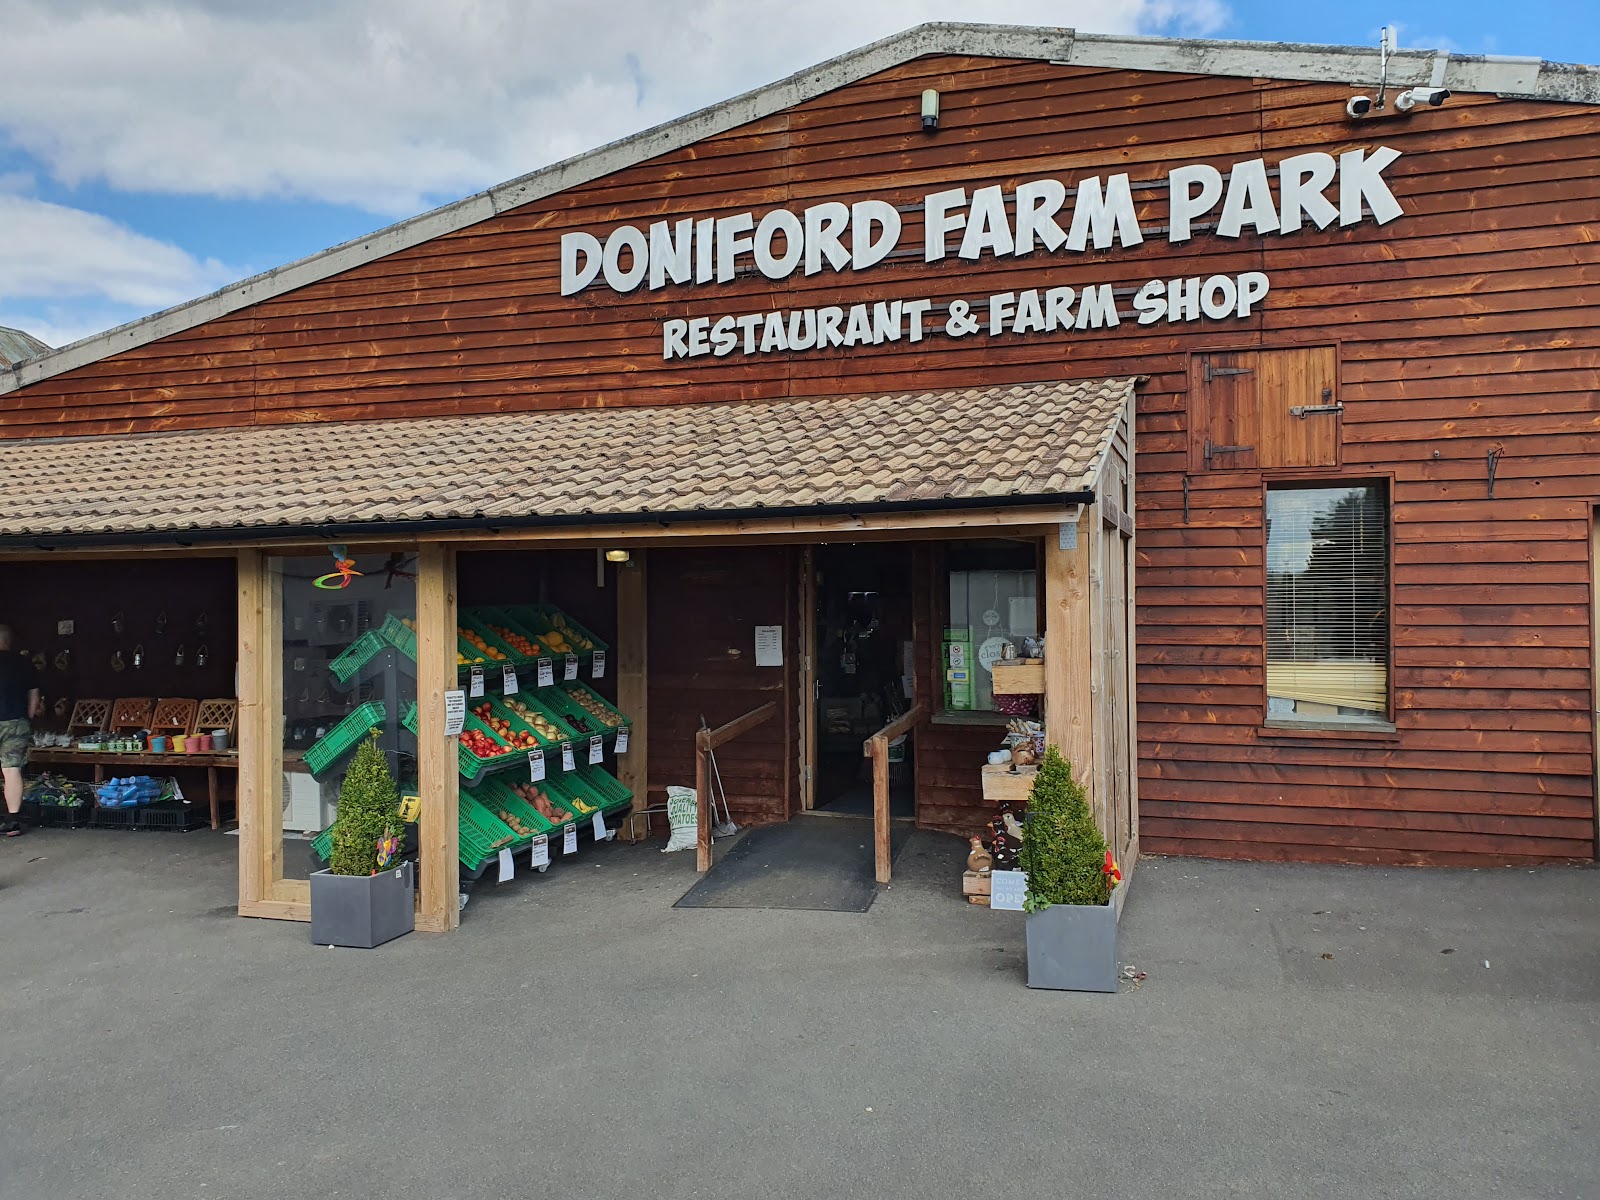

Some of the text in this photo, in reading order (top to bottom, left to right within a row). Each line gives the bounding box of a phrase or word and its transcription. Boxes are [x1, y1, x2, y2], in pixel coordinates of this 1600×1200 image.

[561, 146, 1405, 296] DONIFORD FARM PARK
[663, 271, 1270, 360] RESTAURANT & FARM SHOP
[981, 649, 1001, 659] clos
[996, 893, 1021, 903] OPE
